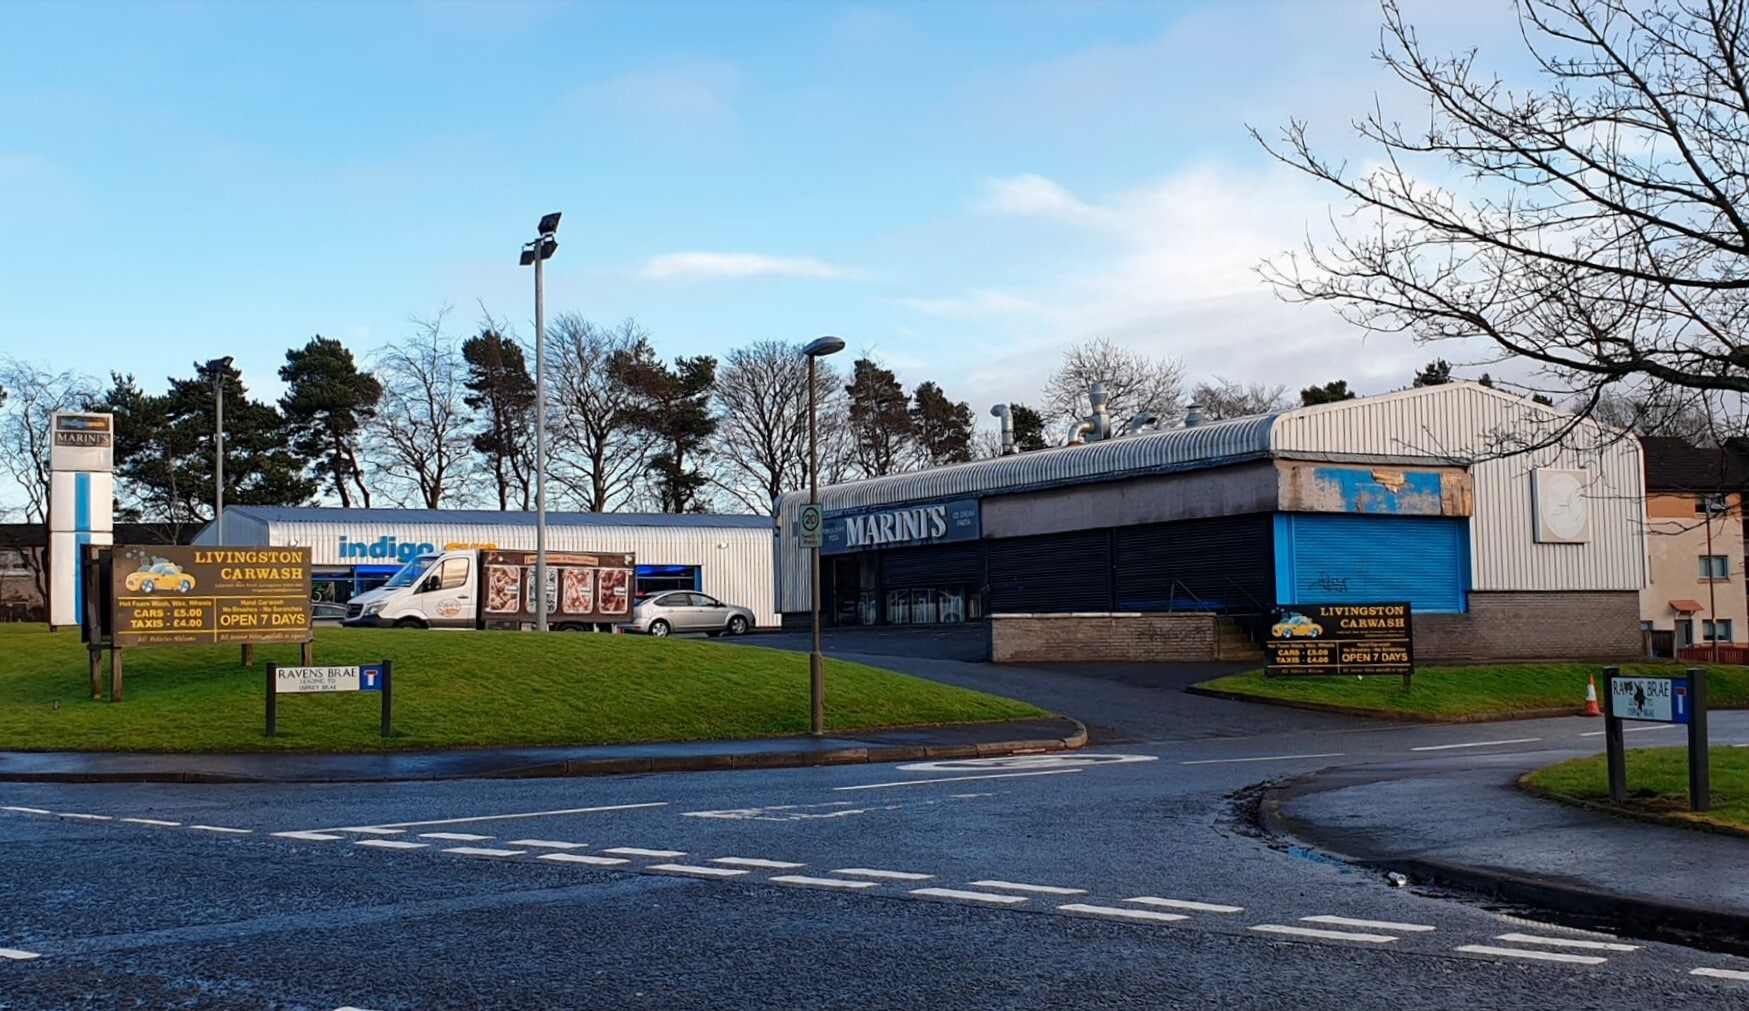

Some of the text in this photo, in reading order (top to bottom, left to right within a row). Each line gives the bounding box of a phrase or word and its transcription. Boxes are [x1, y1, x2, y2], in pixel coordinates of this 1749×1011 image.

[58, 433, 109, 442] MARINI'S
[804, 514, 817, 524] 20
[846, 505, 947, 546] MARINI'S
[339, 535, 435, 563] indigo
[194, 551, 303, 563] LIVINGSTON
[220, 568, 303, 580] CARWASH
[133, 609, 164, 617] CARS
[174, 608, 202, 617] £5.00
[1320, 606, 1404, 616] LIVINGSTON
[130, 619, 164, 628] TAXIS
[173, 619, 202, 627] £4.00
[220, 613, 305, 626] OPEN 7 DAYS
[1340, 619, 1405, 628] CARWASH
[1341, 652, 1408, 662] OPEN 7 DAYS
[278, 668, 357, 679] RAVENS BRAE
[1646, 681, 1669, 697] BRAE
